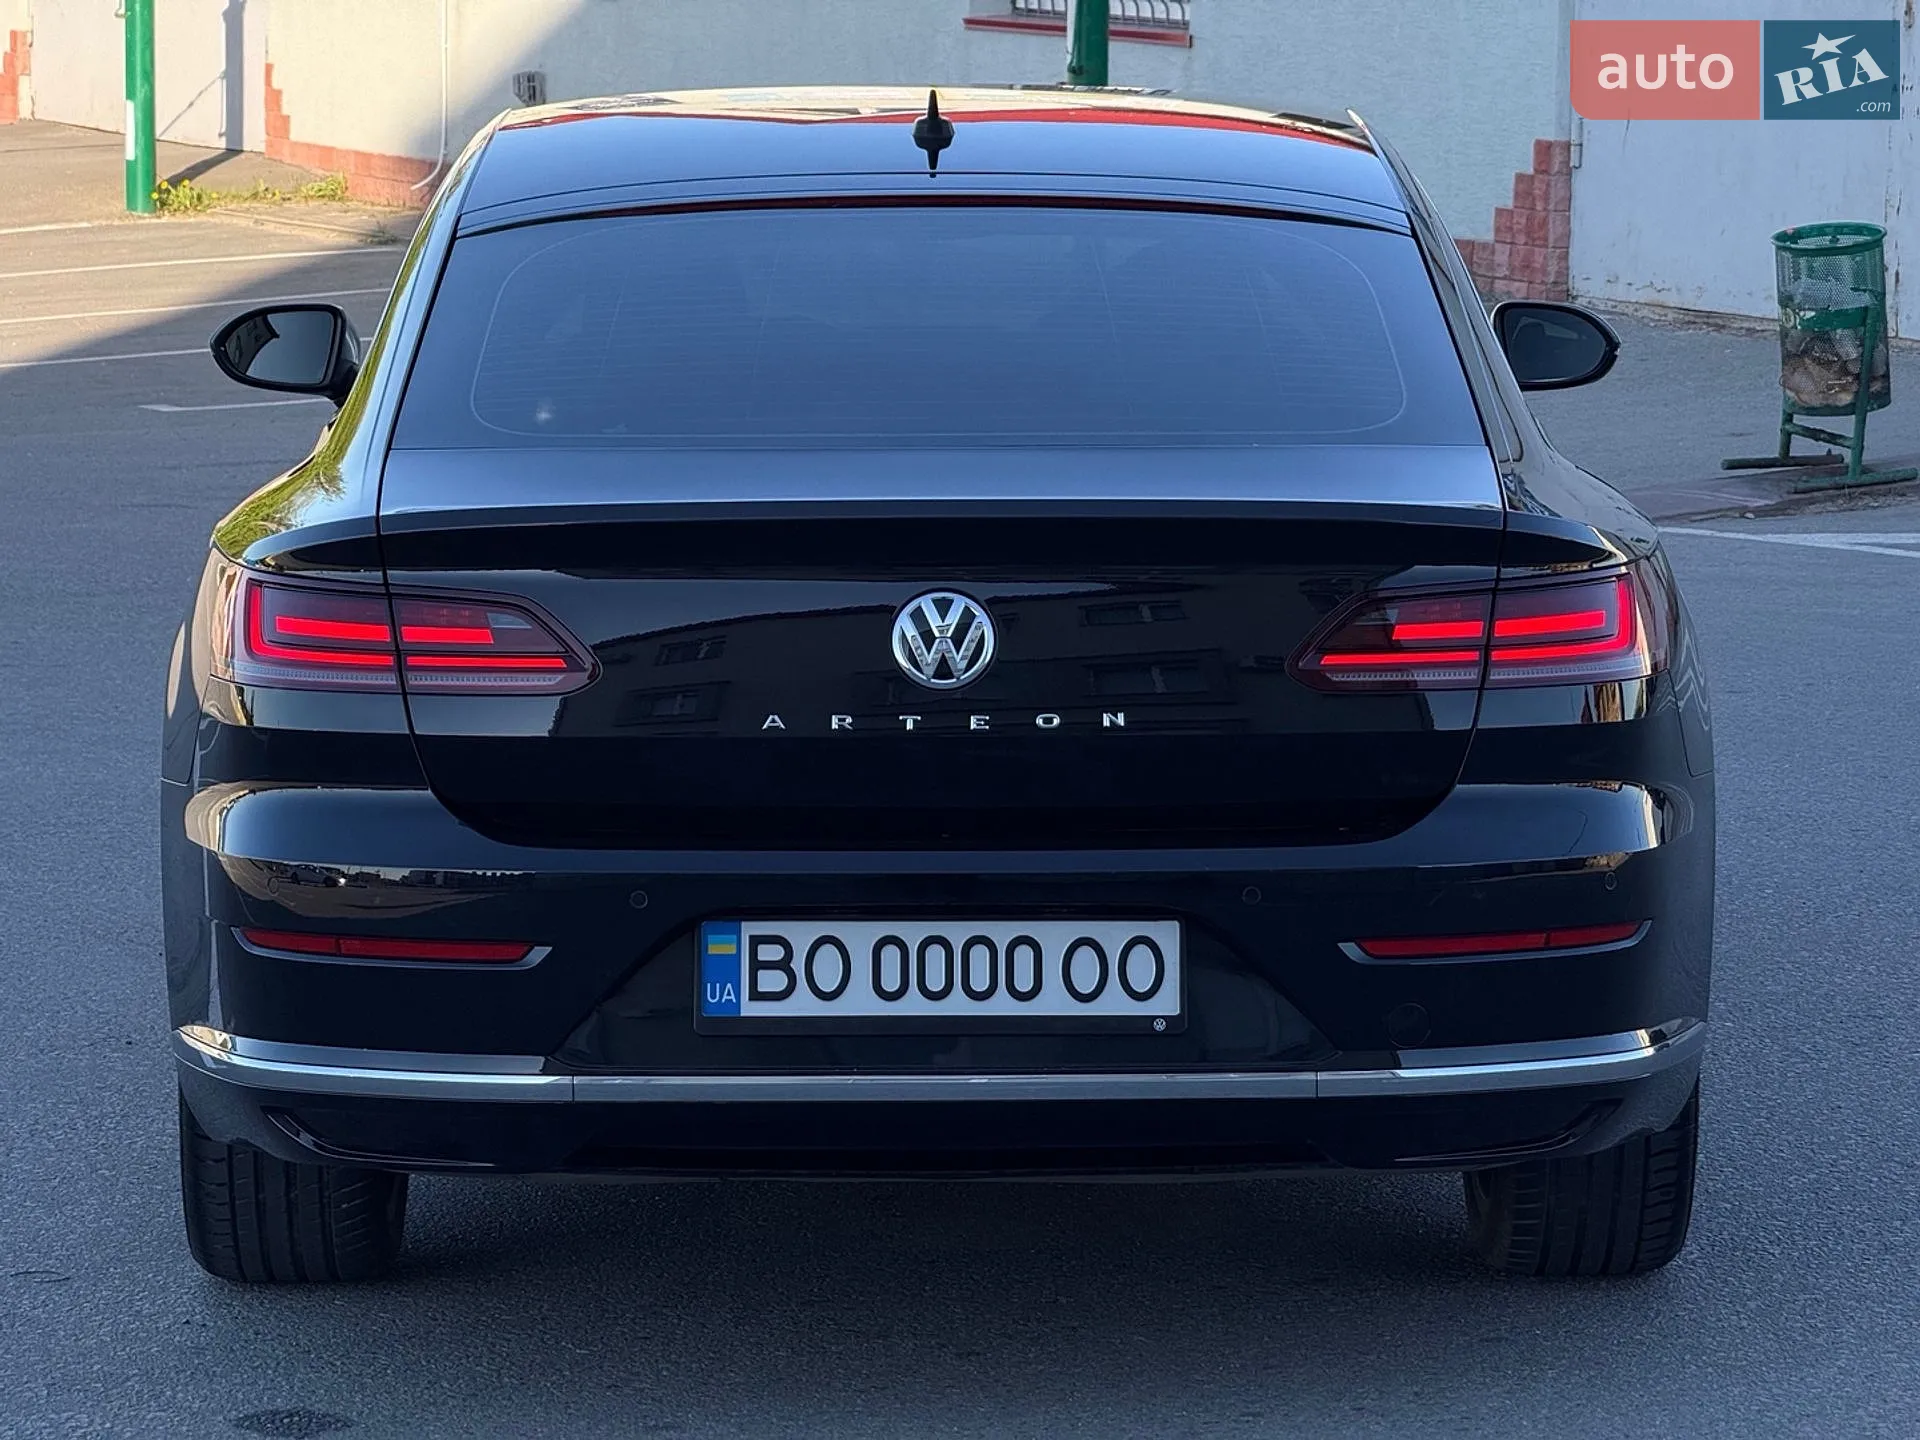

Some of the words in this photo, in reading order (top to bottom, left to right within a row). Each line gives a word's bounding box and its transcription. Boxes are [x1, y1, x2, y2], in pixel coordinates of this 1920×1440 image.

[761, 711, 1125, 731] ARTEON
[747, 934, 852, 1002] BO
[871, 934, 1043, 1002] 0000
[705, 982, 737, 1003] UA
